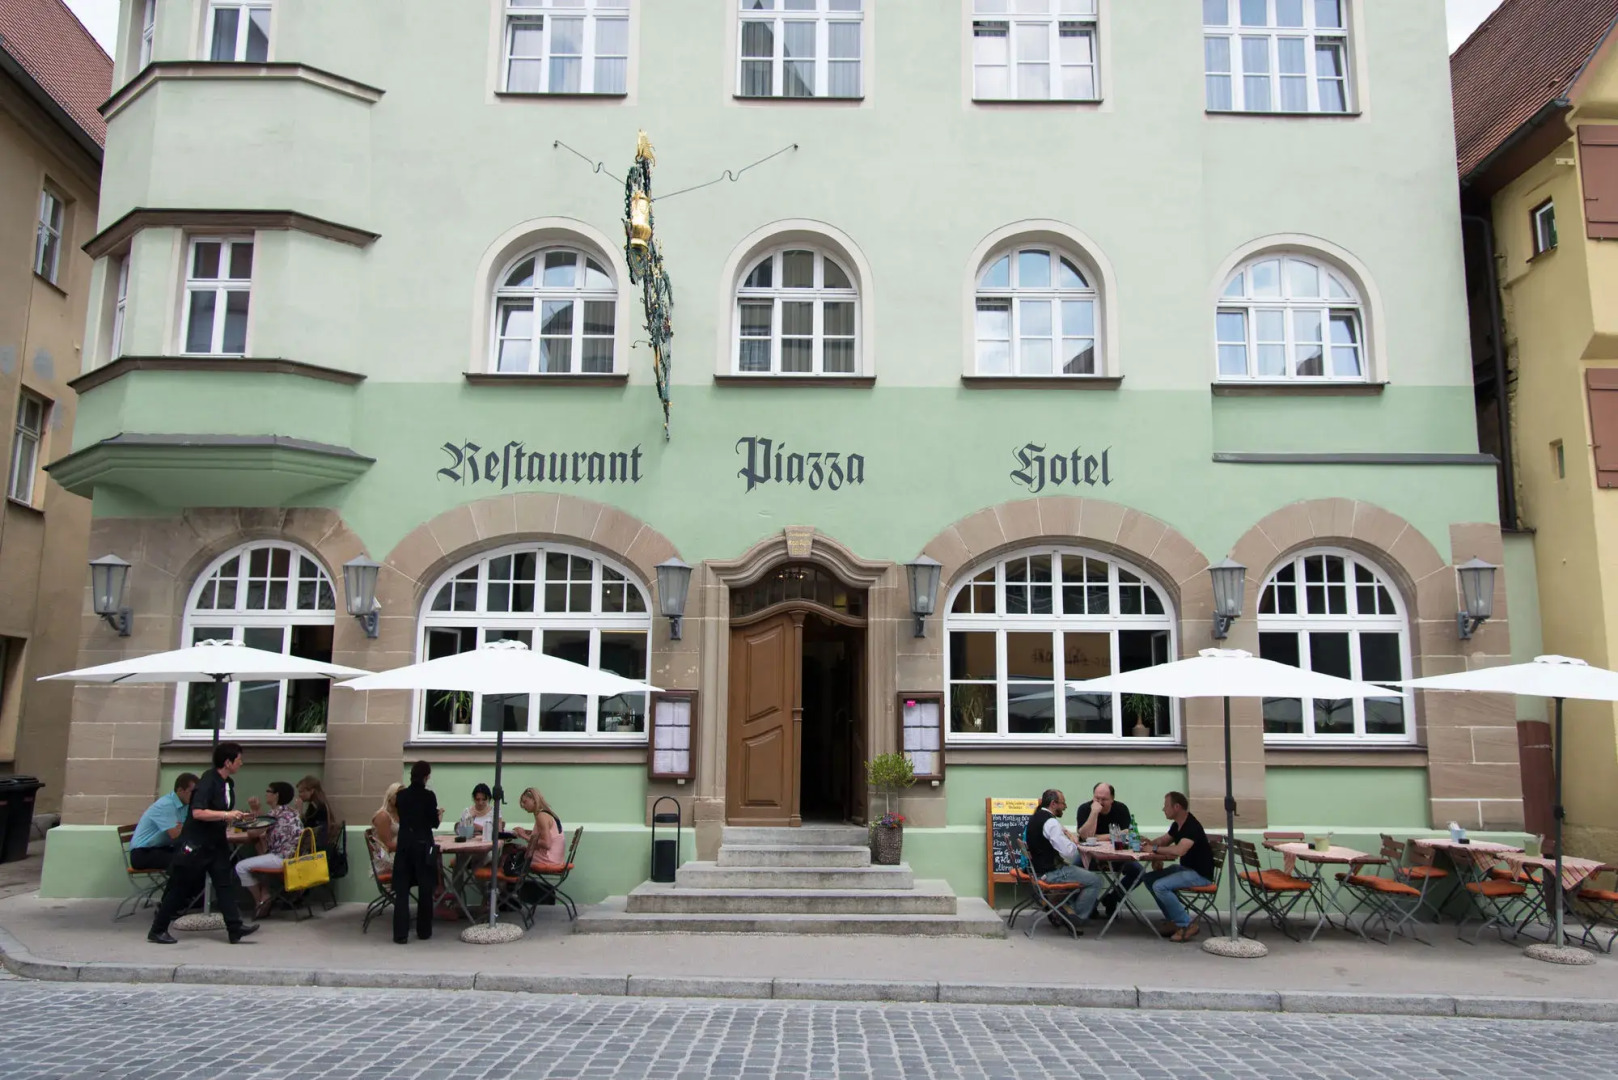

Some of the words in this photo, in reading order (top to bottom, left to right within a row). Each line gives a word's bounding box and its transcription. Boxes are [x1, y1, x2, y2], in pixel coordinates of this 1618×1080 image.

[437, 440, 644, 490] Restaurant
[735, 435, 865, 493] Piazza
[1009, 443, 1113, 494] Hotel
